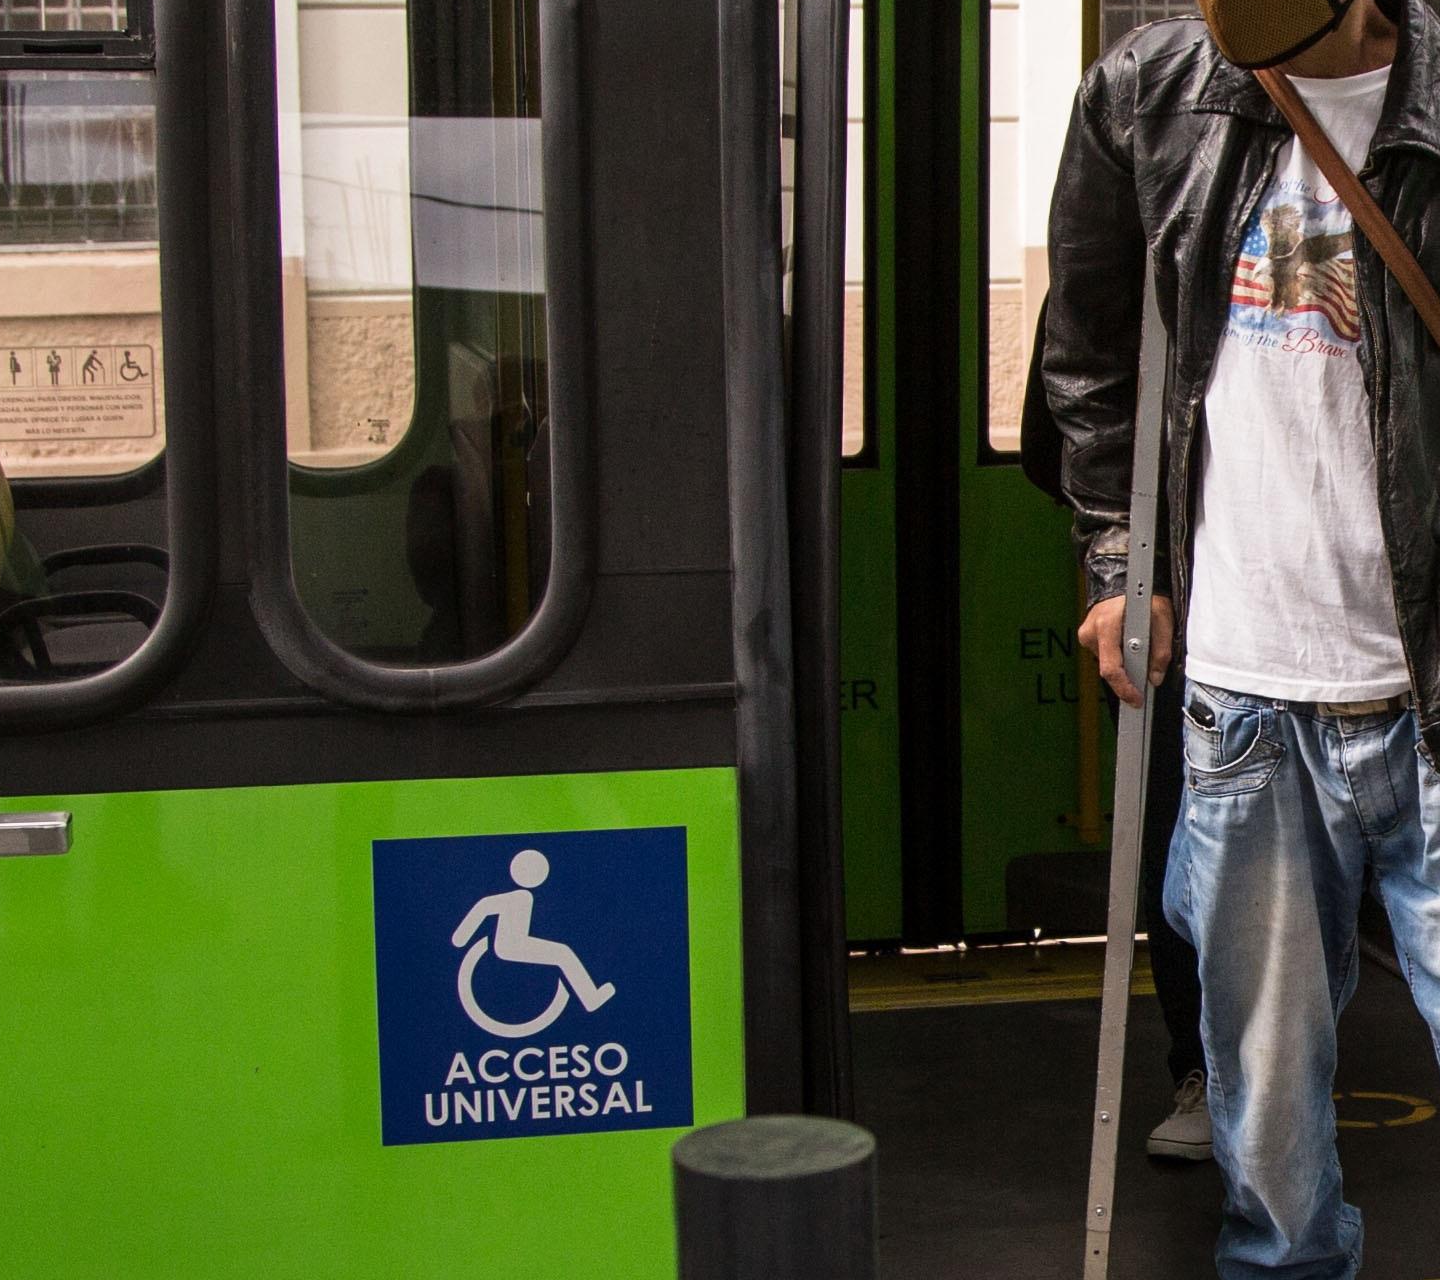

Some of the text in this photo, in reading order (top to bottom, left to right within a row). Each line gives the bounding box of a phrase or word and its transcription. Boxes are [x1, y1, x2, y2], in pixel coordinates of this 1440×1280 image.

[1281, 327, 1349, 358] Brave
[444, 1041, 629, 1086] ACCESO
[424, 1080, 653, 1127] UNIVERSAL
